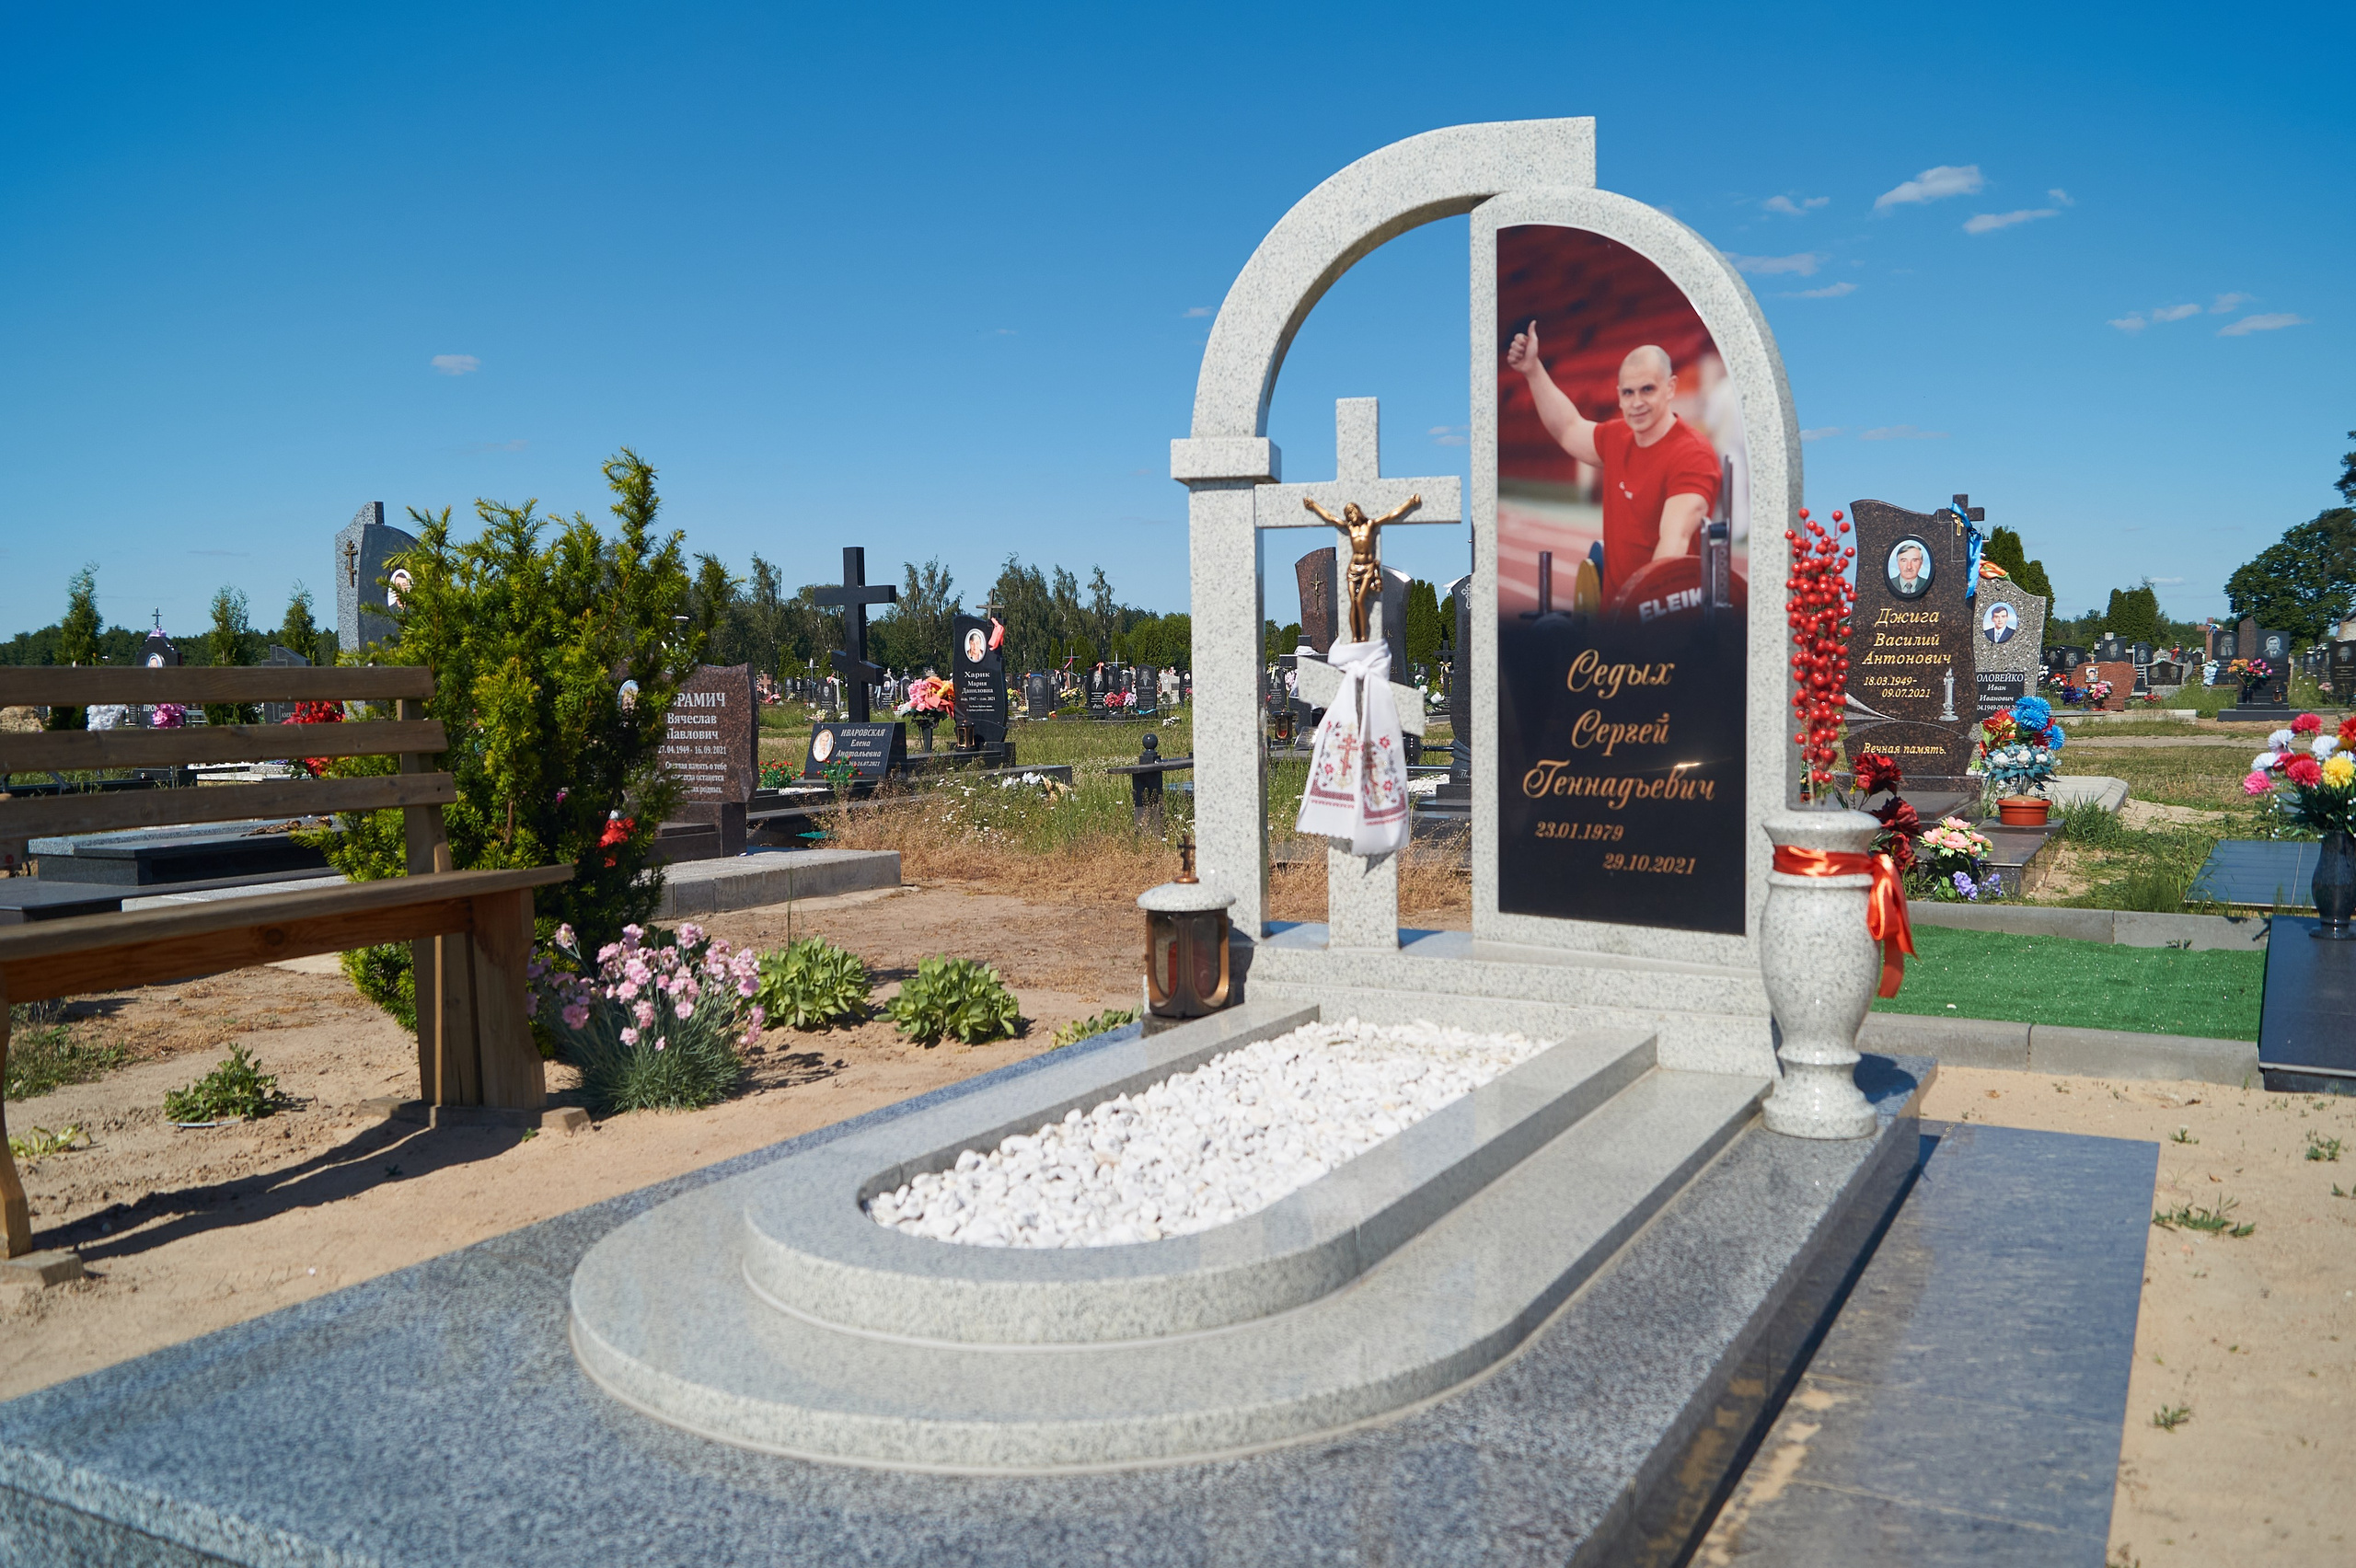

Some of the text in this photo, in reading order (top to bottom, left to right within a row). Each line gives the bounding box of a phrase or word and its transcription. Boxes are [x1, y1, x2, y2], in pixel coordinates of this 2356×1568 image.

[1874, 607, 1940, 628] Джига
[1873, 632, 1940, 646] Василий
[1861, 651, 1951, 664] Антонович
[964, 671, 990, 679] Харик
[1566, 648, 1675, 699] Седых
[1976, 673, 2024, 683] ОЛОВЕЙКО
[1881, 688, 1931, 698] 09.07.2021
[1979, 694, 2014, 702] Иванович
[673, 692, 726, 708] РАМИЧ
[666, 712, 717, 725] Вячеслав
[1571, 709, 1670, 756] Сергей
[849, 739, 872, 747] Елена
[1862, 742, 1946, 755] Вечная память.
[1522, 758, 1715, 810] Геннадьевич
[1534, 820, 1624, 842] 23.01.1979
[1602, 852, 1697, 874] 29.10.2021
